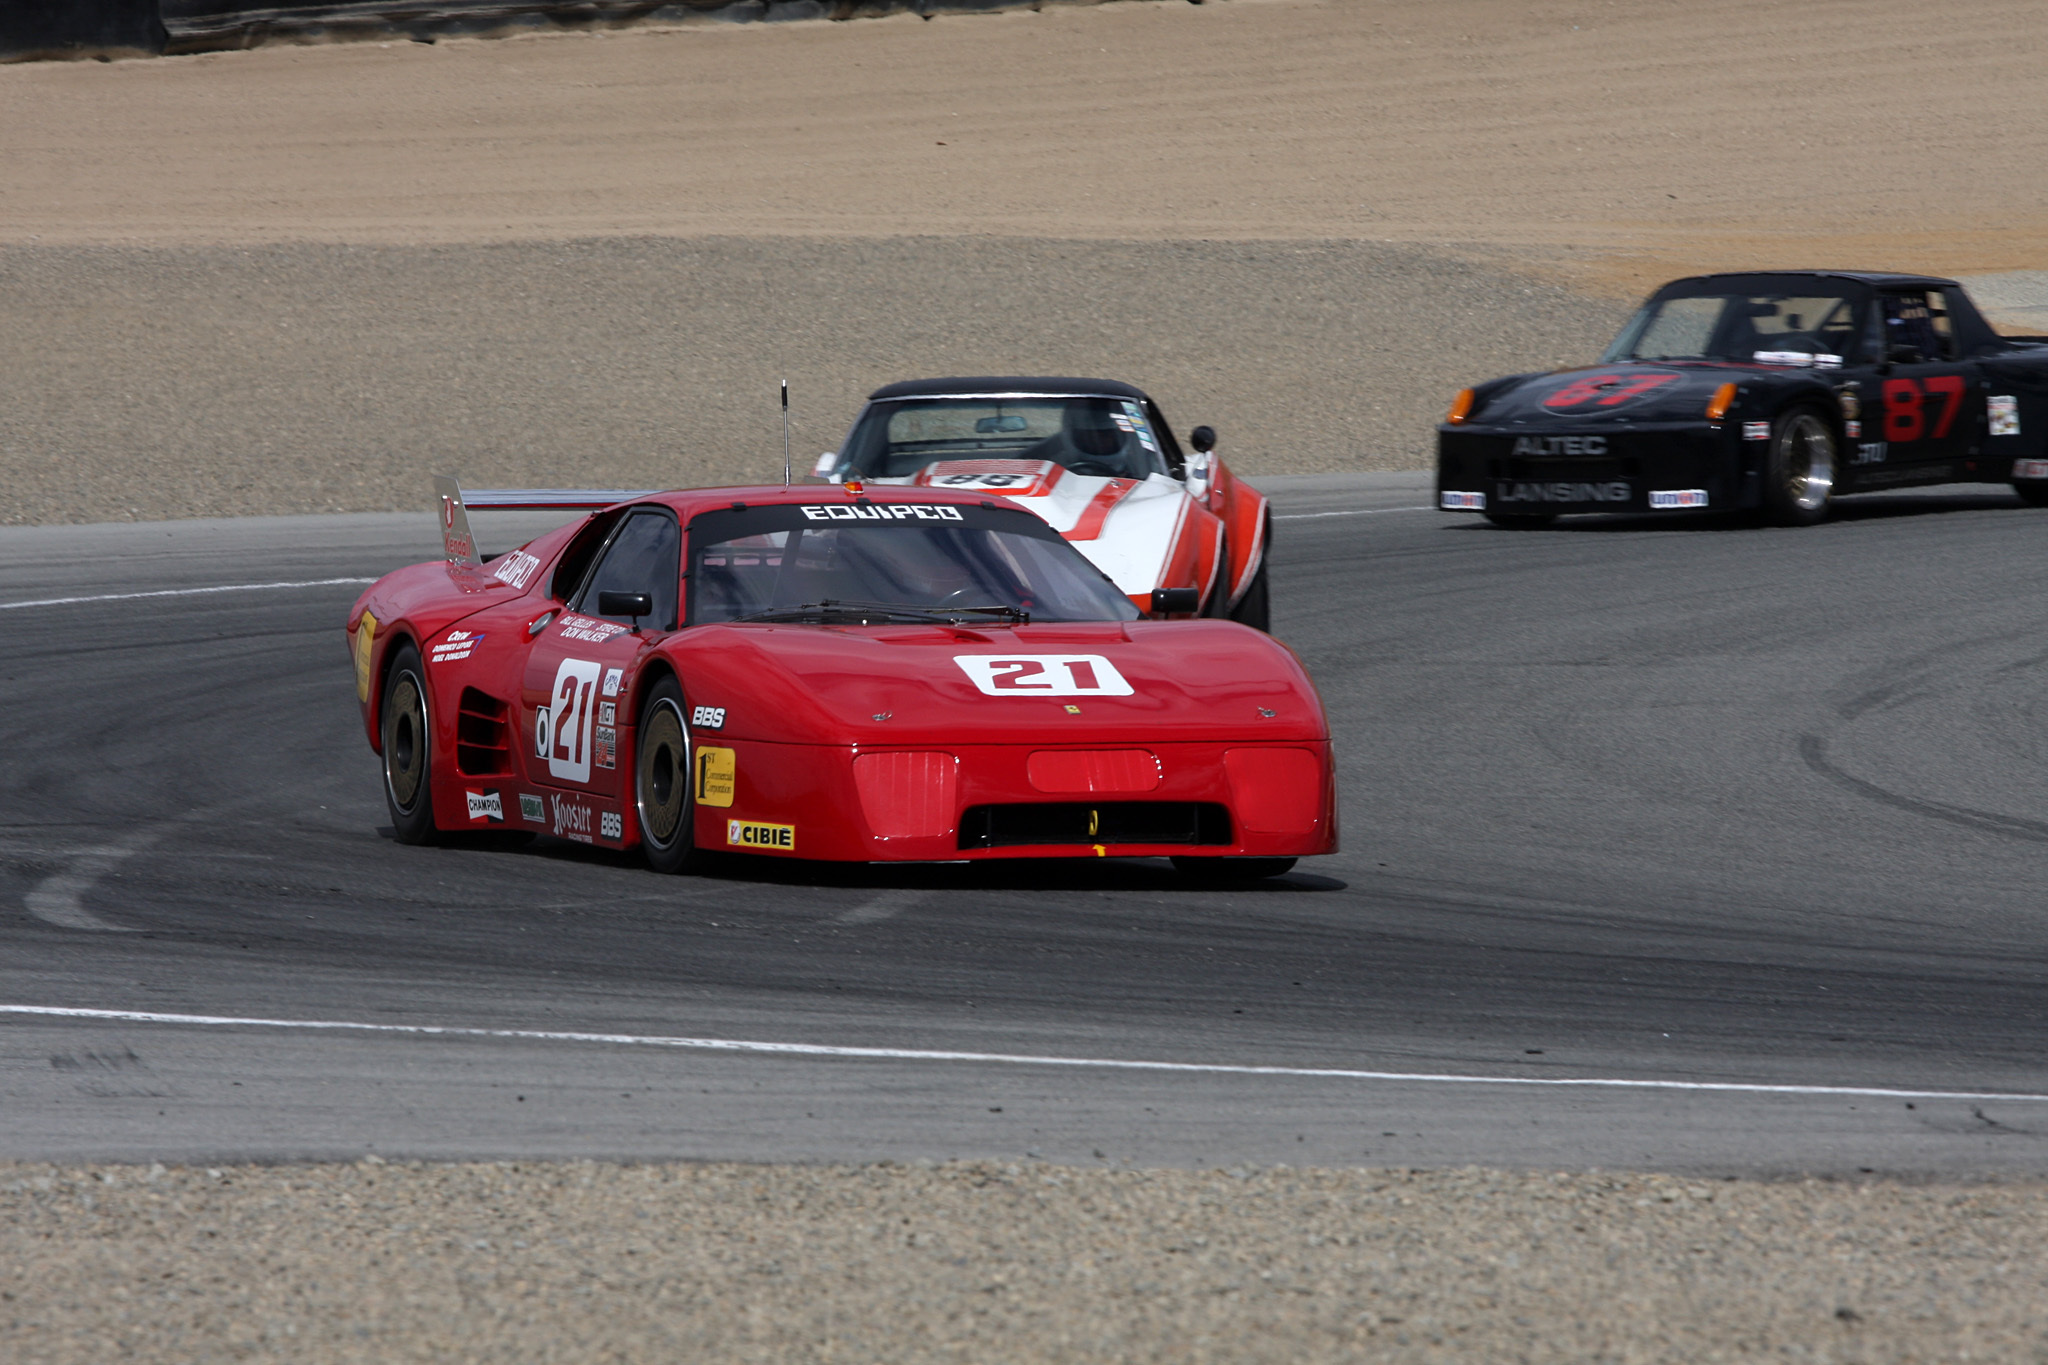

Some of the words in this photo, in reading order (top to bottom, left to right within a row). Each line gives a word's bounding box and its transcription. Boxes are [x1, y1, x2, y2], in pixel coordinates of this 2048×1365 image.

[1542, 375, 1684, 406] 87
[1882, 376, 1966, 442] 87
[1511, 436, 1607, 455] ALTEC
[1497, 482, 1632, 502] LANSING
[800, 505, 964, 520] EQUIPCO
[445, 531, 472, 558] Kendall
[988, 660, 1101, 689] 21
[553, 675, 592, 765] 21
[692, 706, 726, 728] BBS
[469, 799, 501, 812] CHAMPION
[551, 793, 592, 836] Hoosier
[601, 811, 622, 838] BBS
